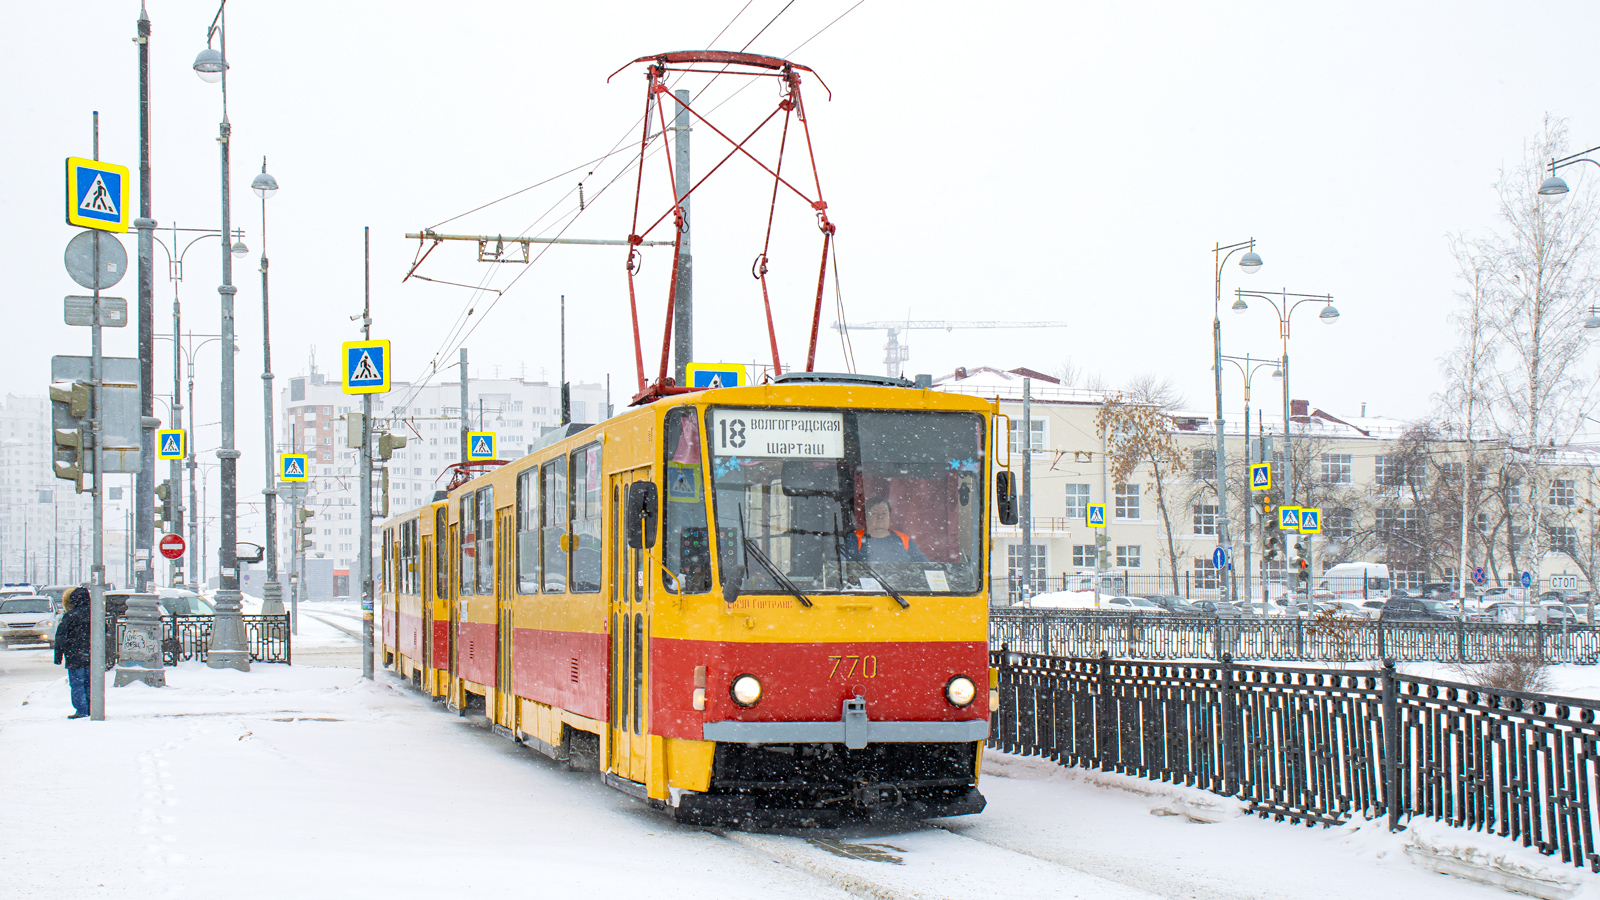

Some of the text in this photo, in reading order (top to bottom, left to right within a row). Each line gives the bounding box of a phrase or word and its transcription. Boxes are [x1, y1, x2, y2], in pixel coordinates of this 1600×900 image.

[720, 419, 746, 448] 18
[1552, 577, 1575, 588] СТОП
[828, 655, 877, 678] 770
